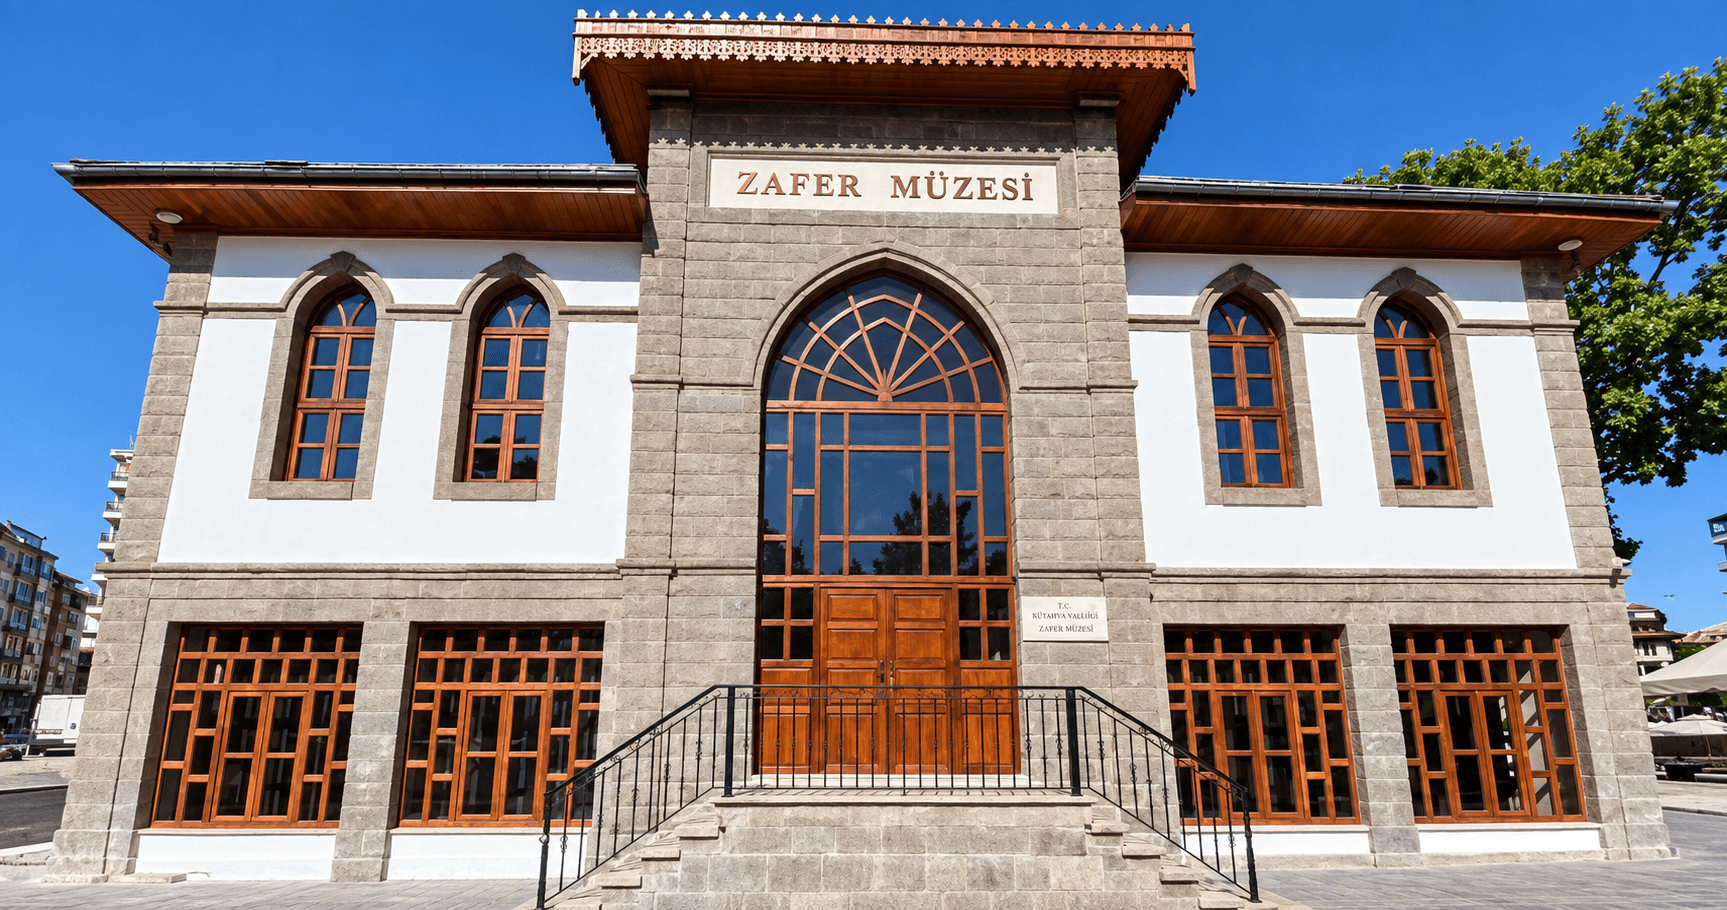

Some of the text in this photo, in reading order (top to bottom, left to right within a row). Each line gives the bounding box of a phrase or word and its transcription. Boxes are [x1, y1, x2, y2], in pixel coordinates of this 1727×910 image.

[737, 170, 1034, 201] ZAFER MÜZESİ
[1065, 624, 1094, 632] MÜZESİ
